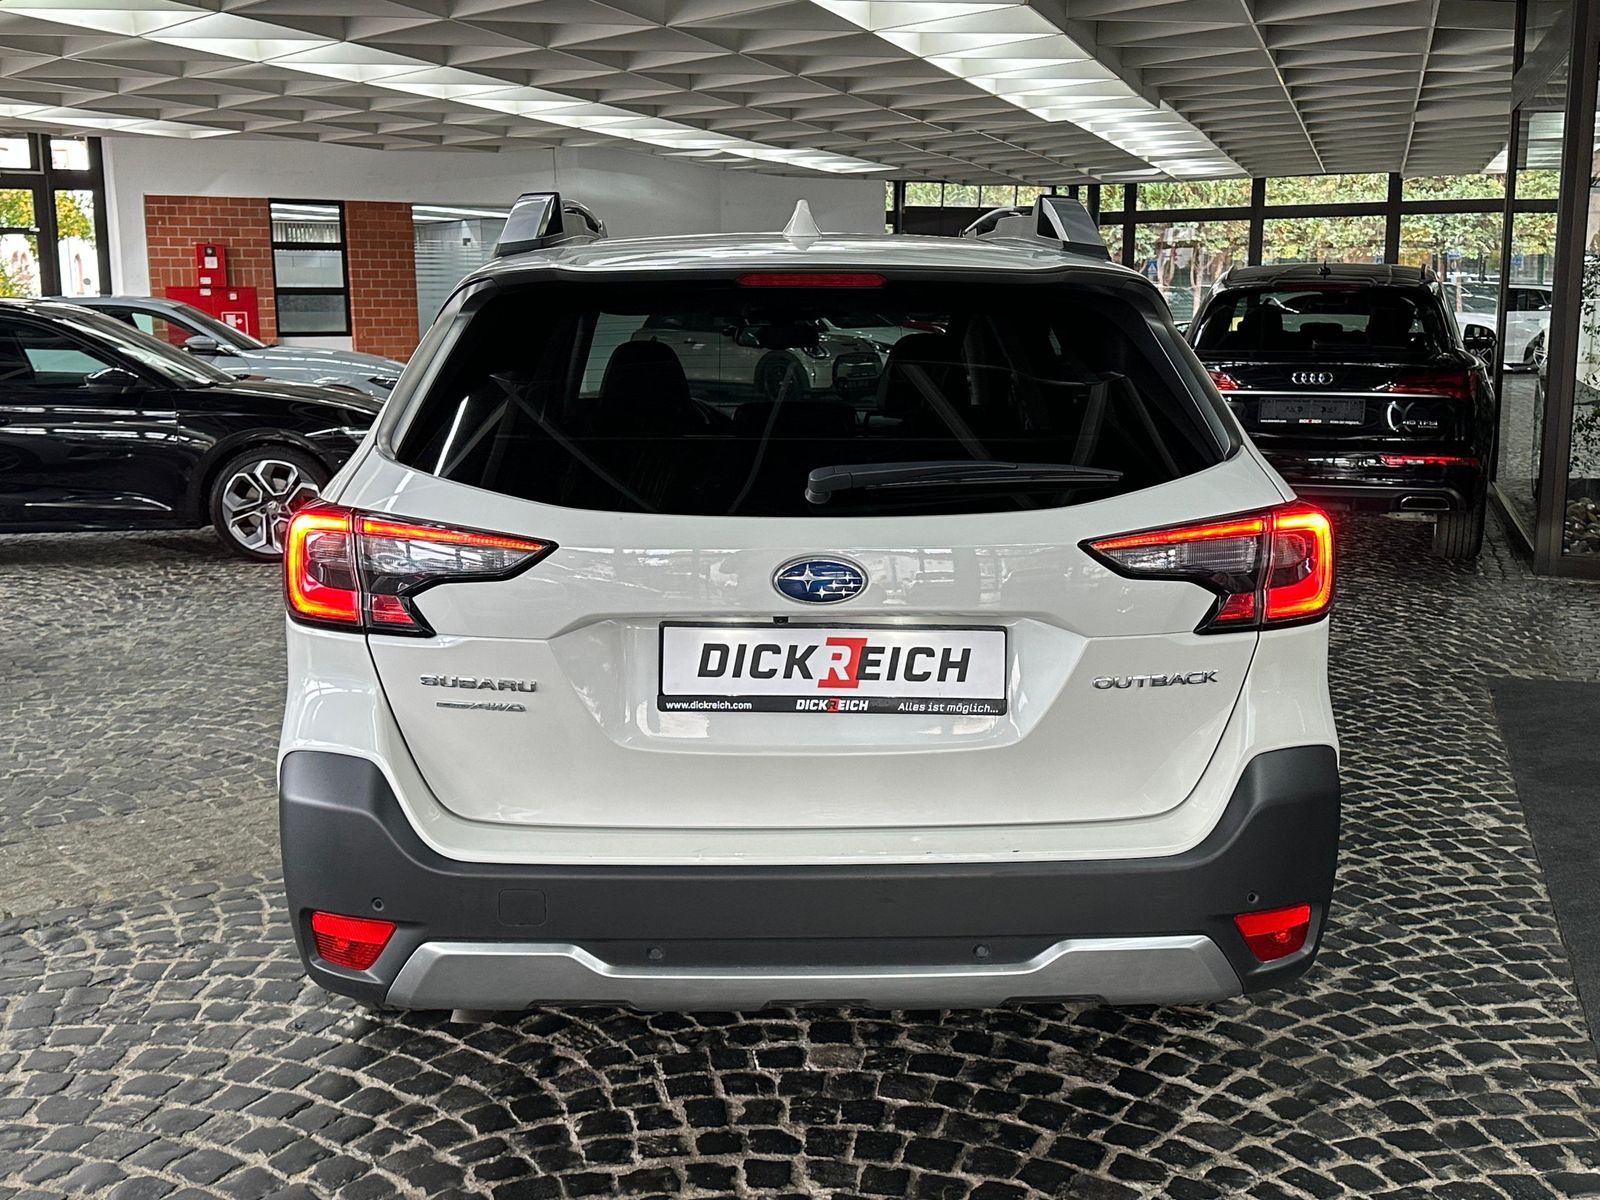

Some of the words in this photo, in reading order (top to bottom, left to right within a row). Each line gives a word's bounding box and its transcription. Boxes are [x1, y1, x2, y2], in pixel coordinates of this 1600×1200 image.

[697, 638, 972, 687] DICKREICH
[420, 674, 537, 693] SUBARU
[1092, 670, 1218, 689] OUTBACK
[665, 700, 752, 710] www.dickreich.com
[795, 698, 869, 711] DICKREICH
[897, 702, 926, 711] Alles
[927, 702, 945, 712] ist
